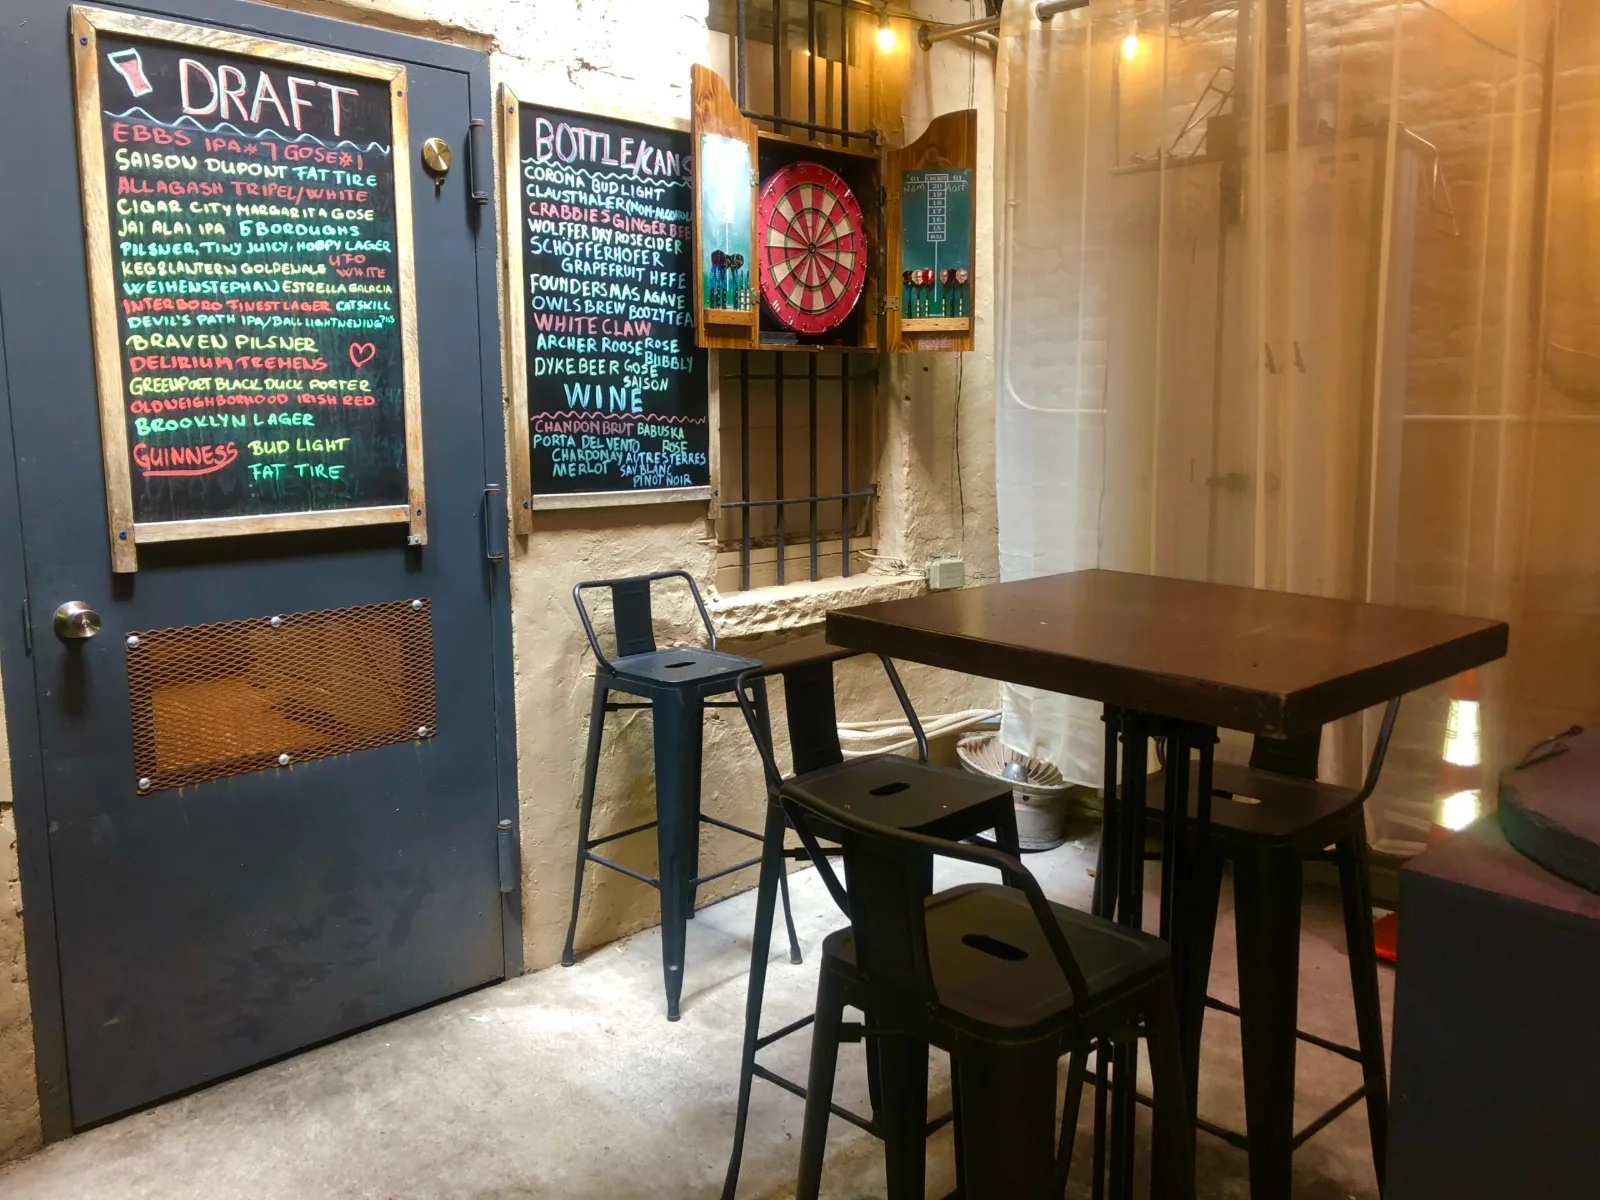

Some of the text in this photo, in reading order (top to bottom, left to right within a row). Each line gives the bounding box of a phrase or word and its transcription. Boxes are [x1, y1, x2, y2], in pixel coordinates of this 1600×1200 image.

[179, 58, 359, 136] DRAFT
[113, 121, 191, 146] EBBS
[115, 148, 377, 187] SAISON DUPONT FAT TIRE
[117, 175, 224, 196] ALLAGASH
[524, 166, 665, 201] CORONA BUD LIGHT
[526, 183, 627, 210] CLAUSTHALER
[116, 198, 374, 220] CIGAR CITY MARGARITA GOSE
[118, 218, 143, 237] JAI
[152, 220, 191, 236] ALAI
[198, 222, 225, 235] IPA
[255, 221, 360, 236] BOROUGHS
[529, 201, 691, 241] CRABBIES GINGER BEE
[528, 218, 682, 256] WOLFFER DRY ROSE CIDER
[120, 241, 199, 256] PILSNER,
[200, 241, 241, 255] TINY
[246, 241, 293, 254] JUICY,
[345, 240, 391, 252] LAGER
[336, 267, 386, 278] WHITE
[561, 257, 687, 290] GRAPEFRUIT HEFE
[122, 279, 280, 296] WEIHENSTEPHAN
[282, 280, 347, 294] ESTRELLA
[530, 274, 686, 310] FOUNDERS MAS AGAVE
[122, 297, 391, 315] INTERBORO FINEST LAGER CATSKILL
[532, 295, 694, 328] OWLS BREW BOOZY TEA
[127, 314, 191, 329] DEVIL'S
[196, 314, 235, 326] PATH
[533, 312, 652, 337] WHITE CLAW
[126, 333, 319, 352] BRAVEN PILSNER
[536, 333, 680, 357] ARCHER ROOSE ROSE
[129, 355, 328, 373] DELIRIUM TREMENS
[534, 356, 658, 378] DYKE BEER GOSE
[645, 351, 693, 373] BUBBLY
[129, 376, 371, 395] GREENPORT BLACK DUCK PORTER
[623, 375, 669, 391] SAISON
[297, 393, 337, 405] IRISH
[342, 395, 376, 406] RED
[564, 382, 643, 413] WINE
[135, 412, 315, 436] BROOKLYN LAGER
[535, 420, 684, 440] CHANDON BRUT BABUSKA
[133, 437, 350, 469] GUINNESS BUD LIGHT
[533, 433, 640, 453] PORTA DEL VENTO
[662, 439, 688, 454] ROSE
[551, 447, 706, 466] CHARDONAY AUTRES TERRES
[248, 463, 345, 480] FAT TIRE
[552, 459, 611, 477] MERLOT
[619, 464, 672, 478] SAV BLANC
[633, 473, 692, 487] PINOT NOIR
